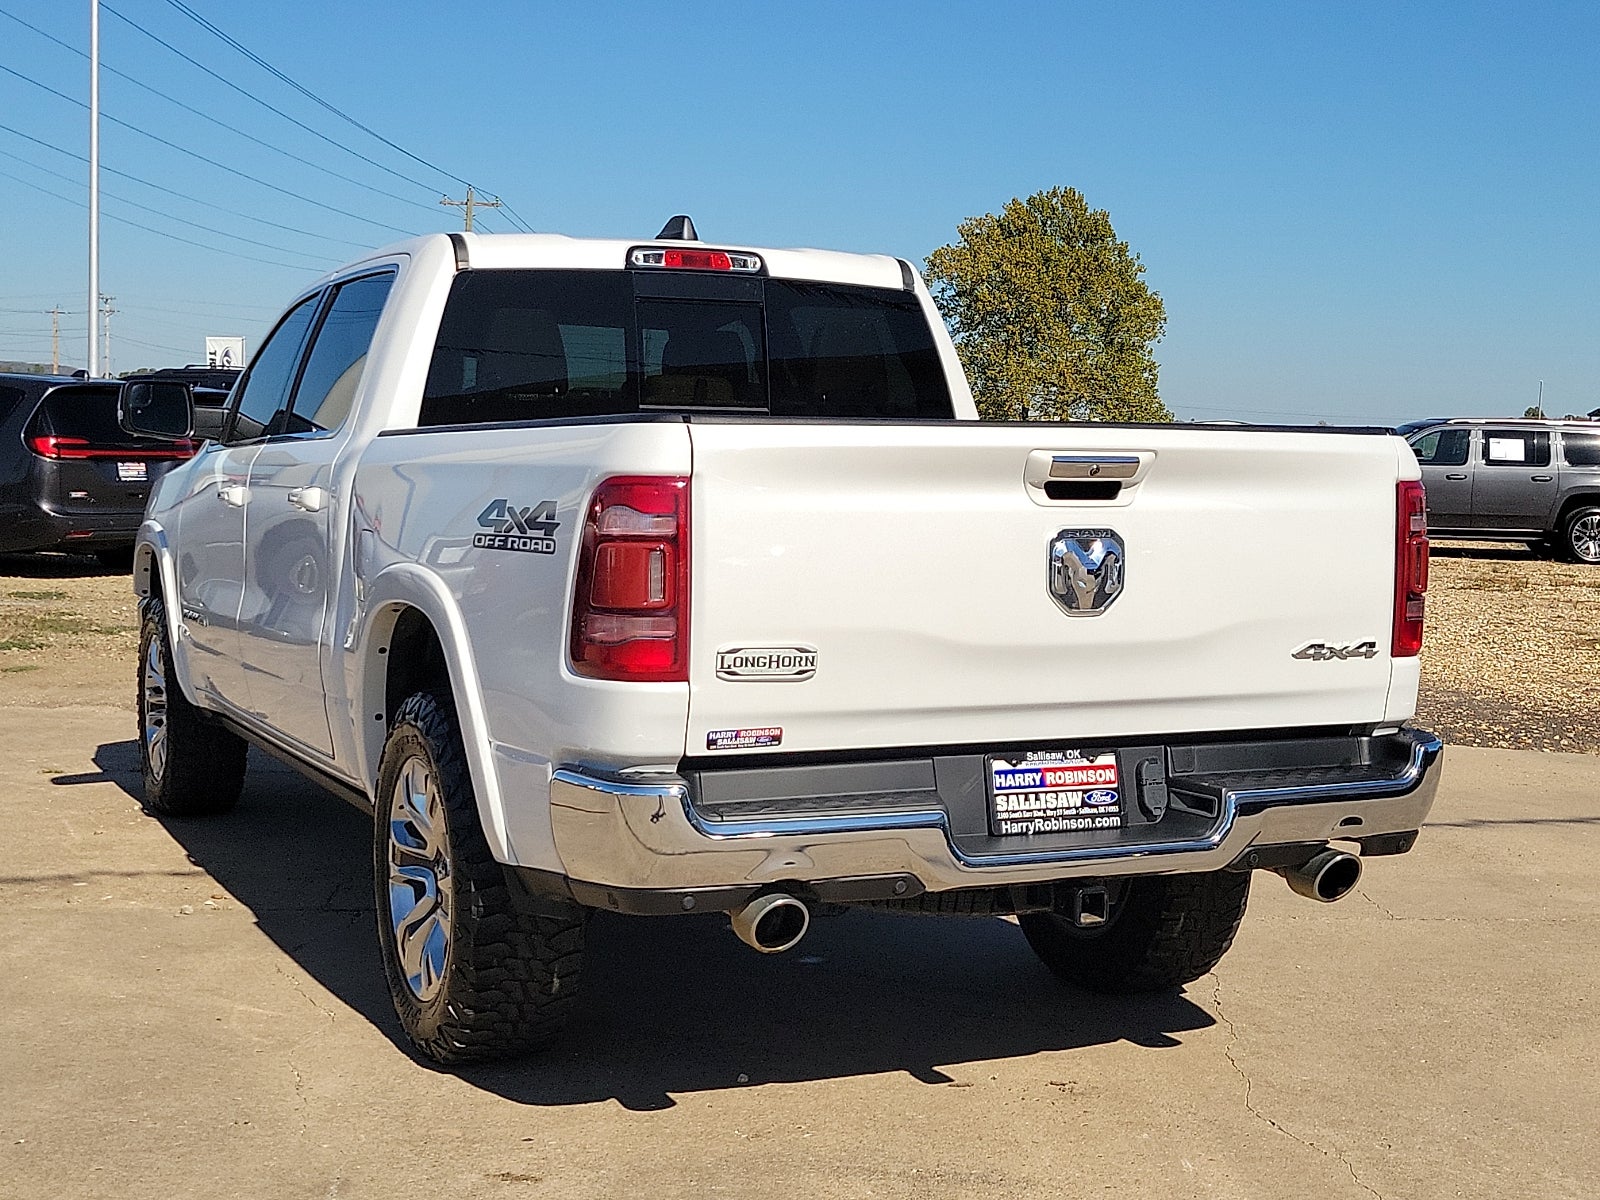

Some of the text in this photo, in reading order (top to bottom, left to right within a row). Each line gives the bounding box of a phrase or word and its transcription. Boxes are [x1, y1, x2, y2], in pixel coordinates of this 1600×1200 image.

[1064, 529, 1111, 538] RAM
[474, 535, 555, 552] OFF ROAD
[709, 728, 781, 740] HARRY ROBINSON
[717, 737, 757, 745] SALLISAW
[1026, 749, 1081, 761] Sallisaw, OK
[994, 768, 1116, 788] HARRY ROBINSON
[995, 790, 1114, 812] SALLISAW Ford
[1002, 816, 1121, 835] HarryRobinson.com
